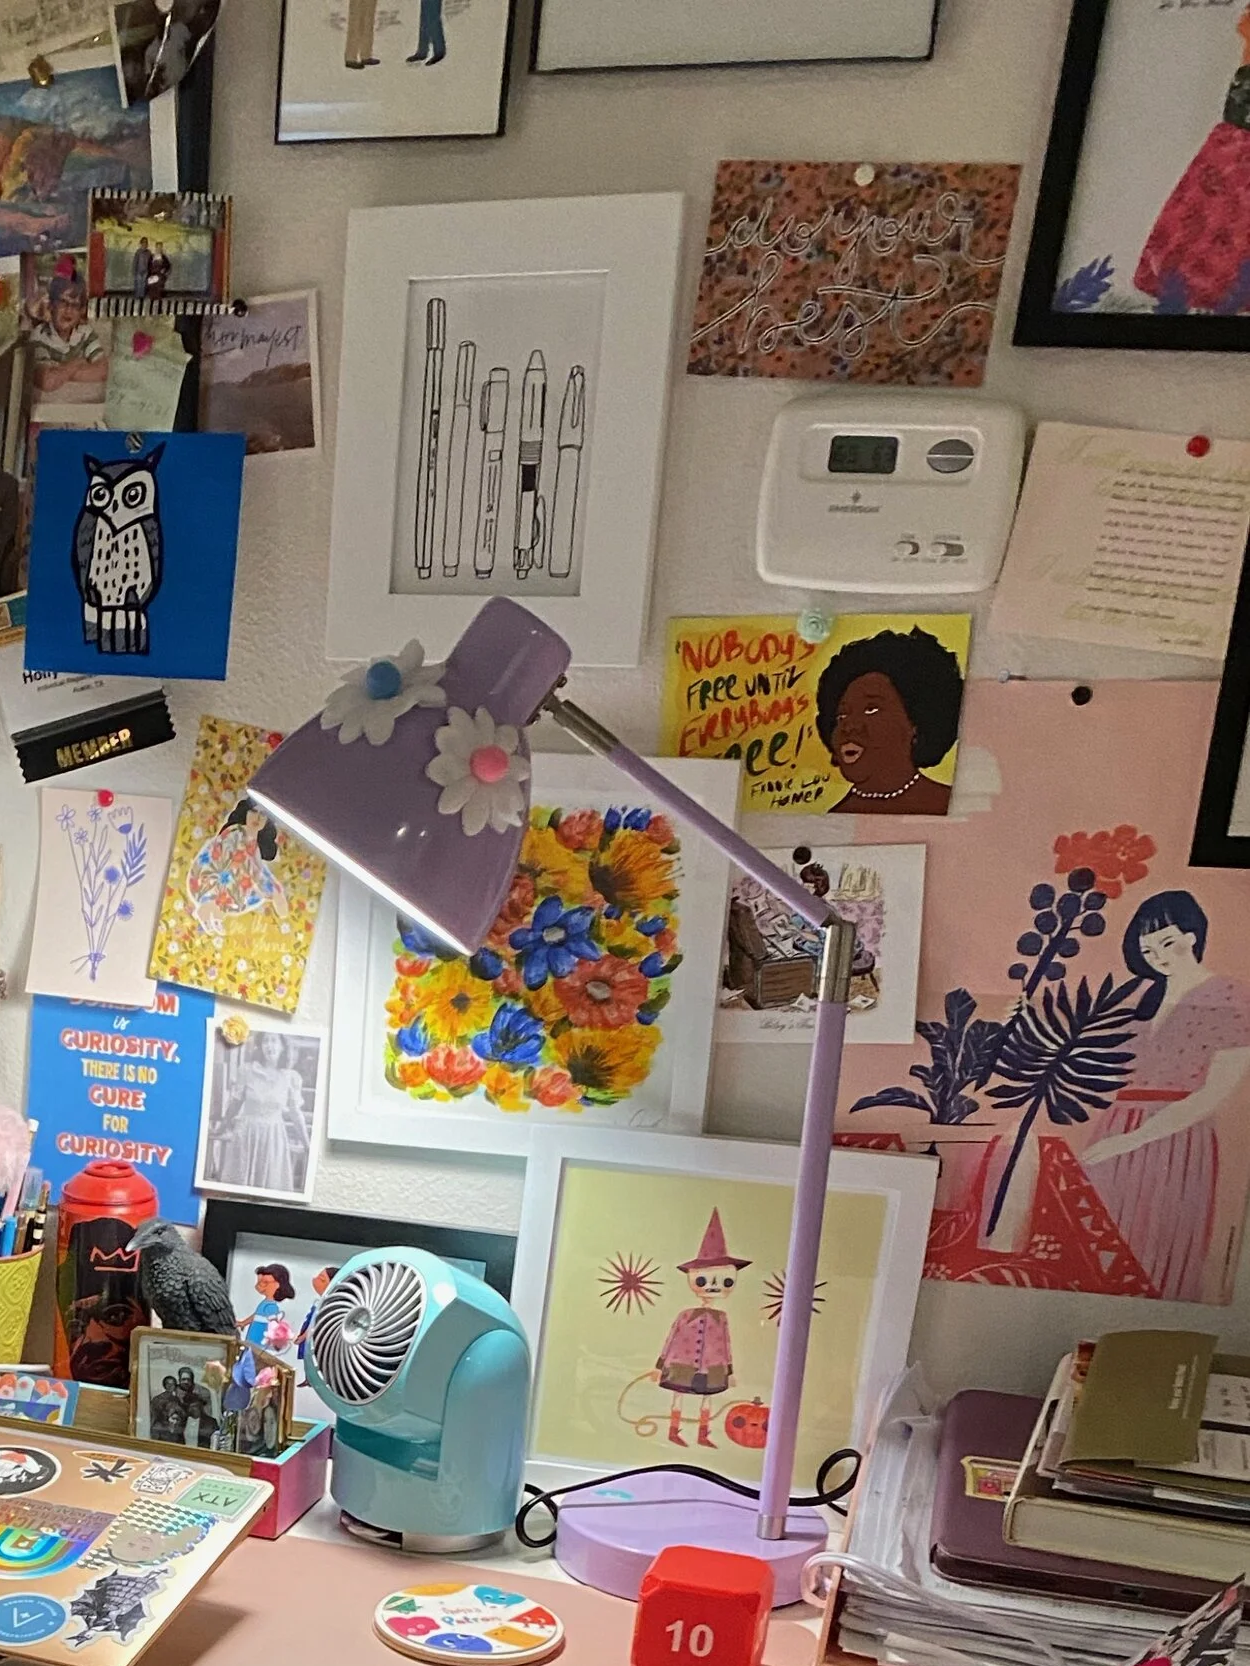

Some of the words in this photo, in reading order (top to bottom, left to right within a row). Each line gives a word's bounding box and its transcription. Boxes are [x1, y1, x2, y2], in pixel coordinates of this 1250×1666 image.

[704, 196, 834, 257] do
[834, 192, 1006, 285] your
[691, 250, 996, 359] best
[56, 728, 134, 768] MEMBER
[113, 1015, 131, 1031] is
[60, 1028, 181, 1064] CURIOSITY.
[81, 1057, 121, 1081] THERE
[122, 1064, 136, 1082] IS
[137, 1065, 158, 1085] NO
[89, 1083, 147, 1111] CURE
[102, 1113, 130, 1134] FOR
[56, 1132, 174, 1168] CURIOSITY
[192, 1491, 239, 1508] ATX
[665, 1619, 714, 1657] 10
